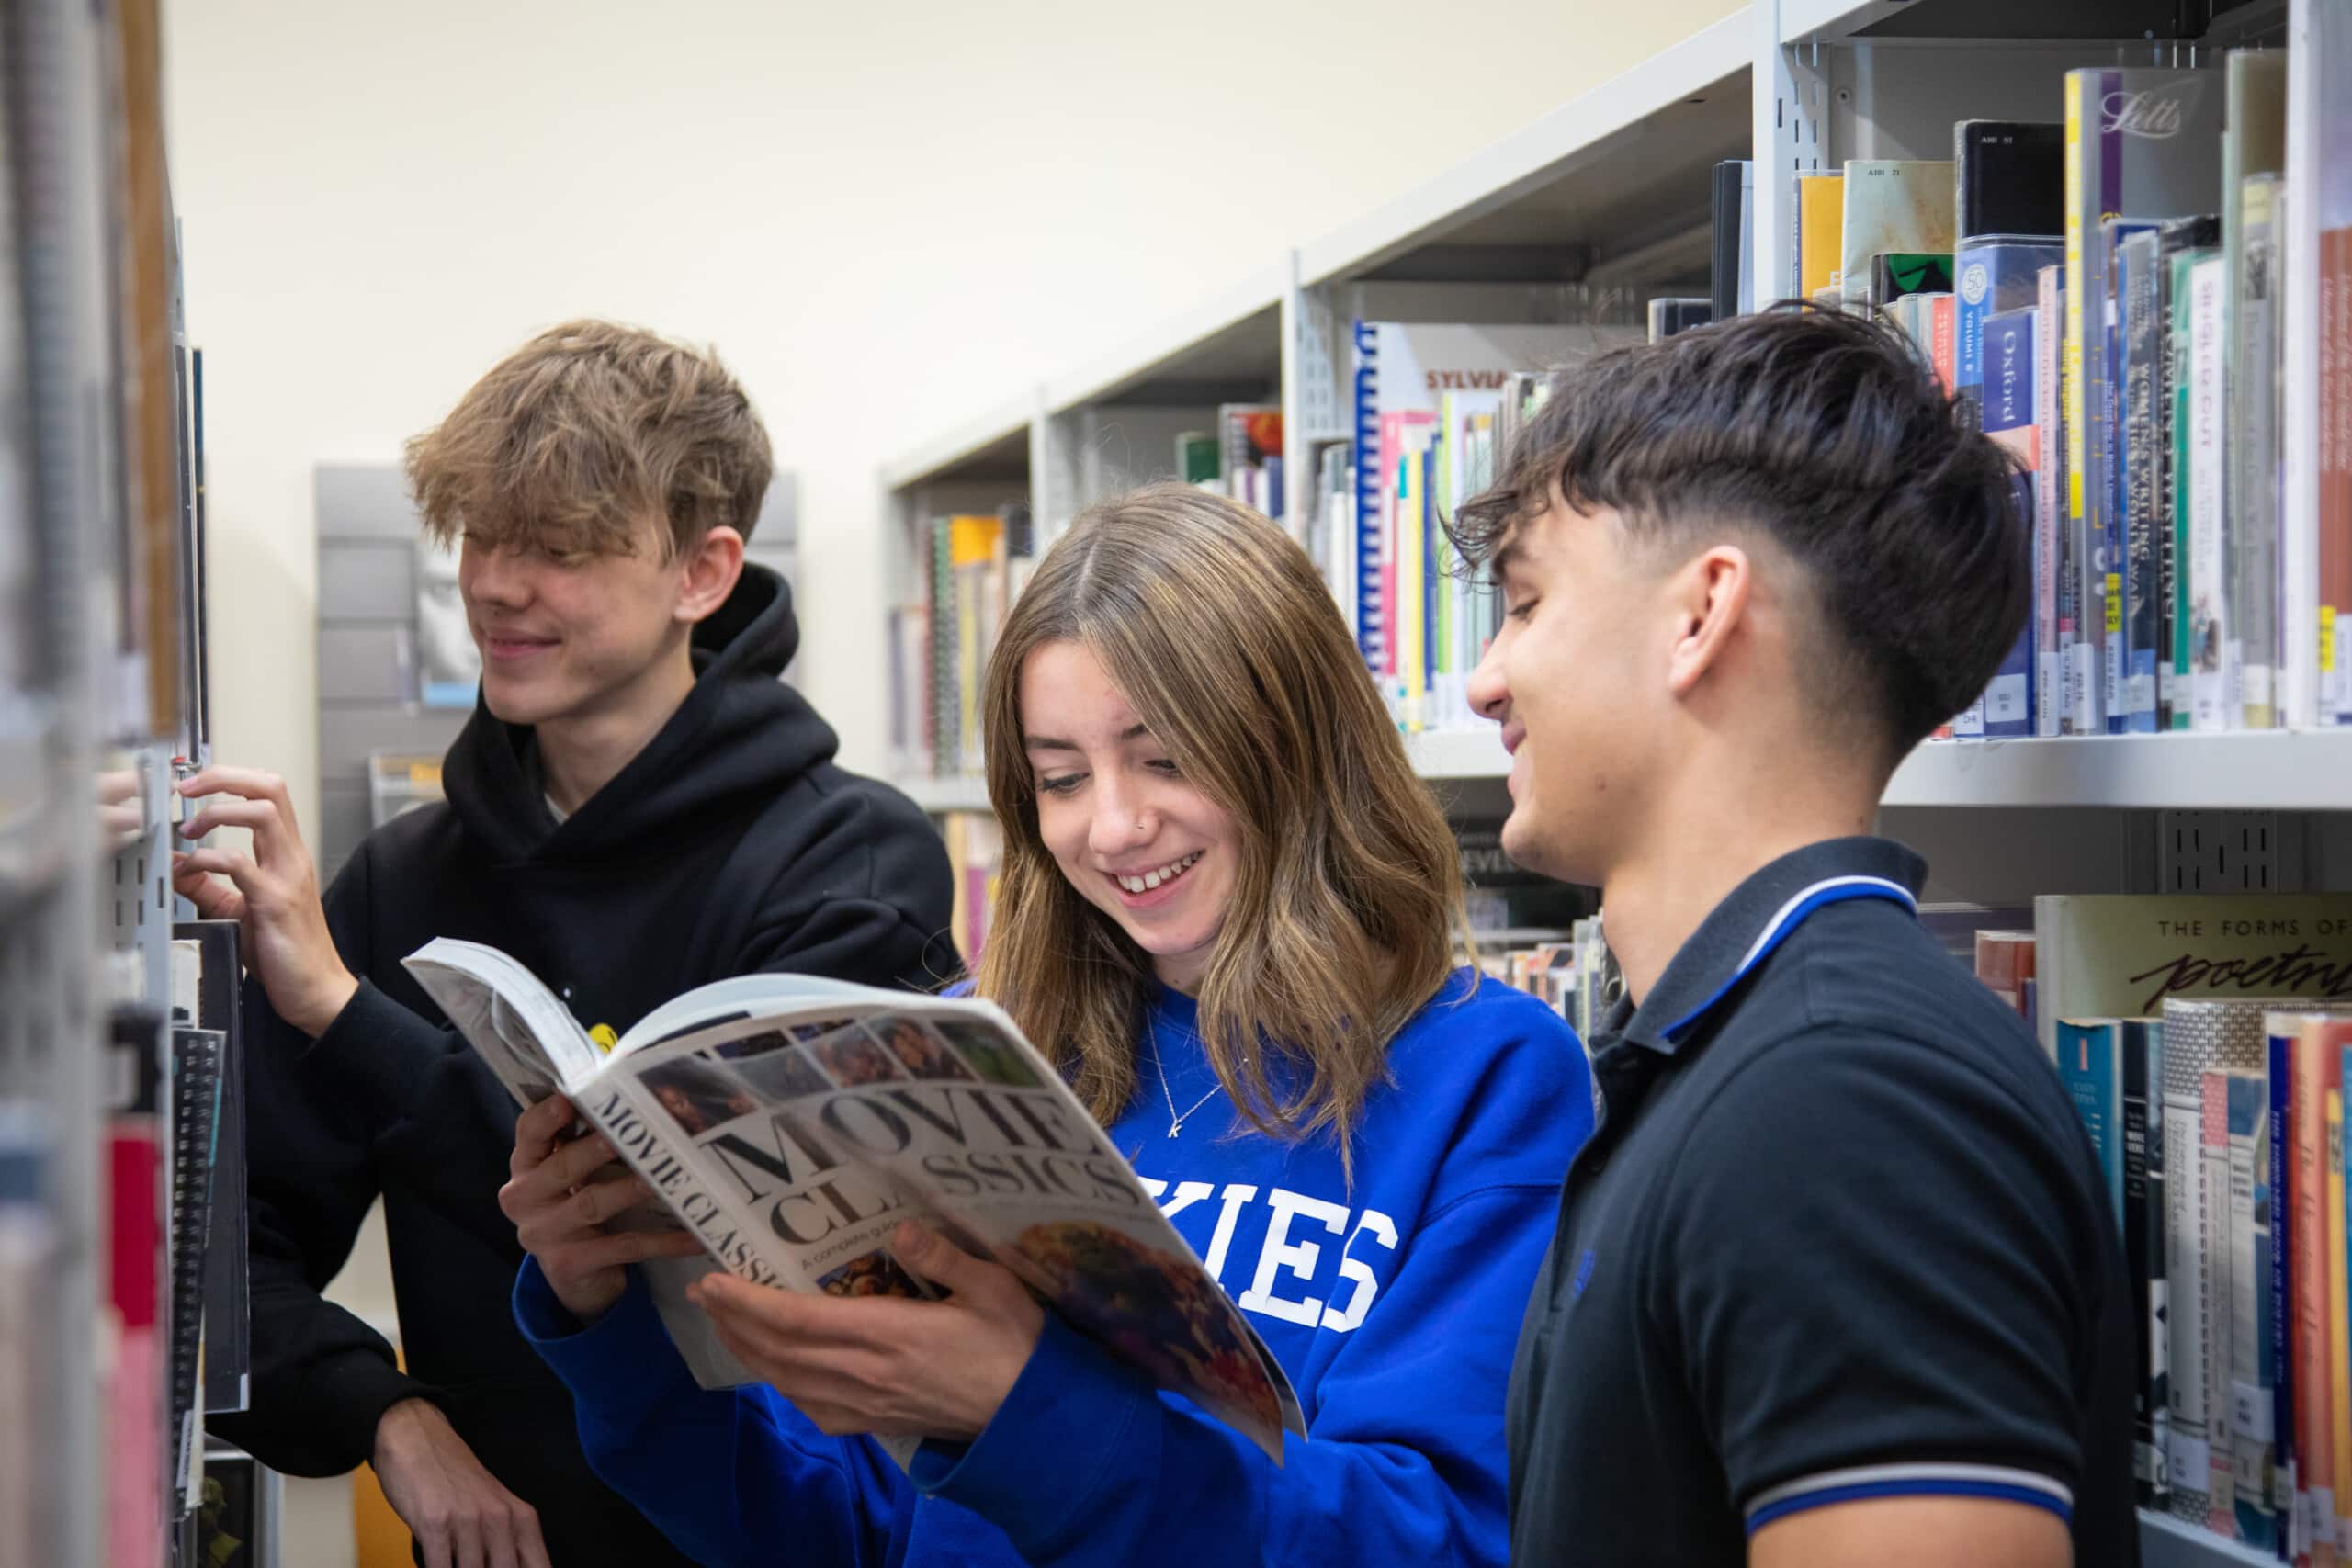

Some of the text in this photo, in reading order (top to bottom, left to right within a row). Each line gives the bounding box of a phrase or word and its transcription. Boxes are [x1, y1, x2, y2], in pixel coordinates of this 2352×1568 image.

[1965, 310, 1974, 359] VOLUME
[2000, 330, 2018, 423] Oxford
[2201, 280, 2213, 447] SINGLED OUT
[2129, 417, 2139, 471] FIRST
[2129, 481, 2139, 558] WORLD
[2139, 468, 2150, 560] WRITING
[2158, 919, 2350, 937] THE FORMS OF
[594, 1093, 693, 1197] MOVIE
[698, 1087, 1103, 1205] MOVIE
[770, 1153, 1141, 1246] CLSSICS
